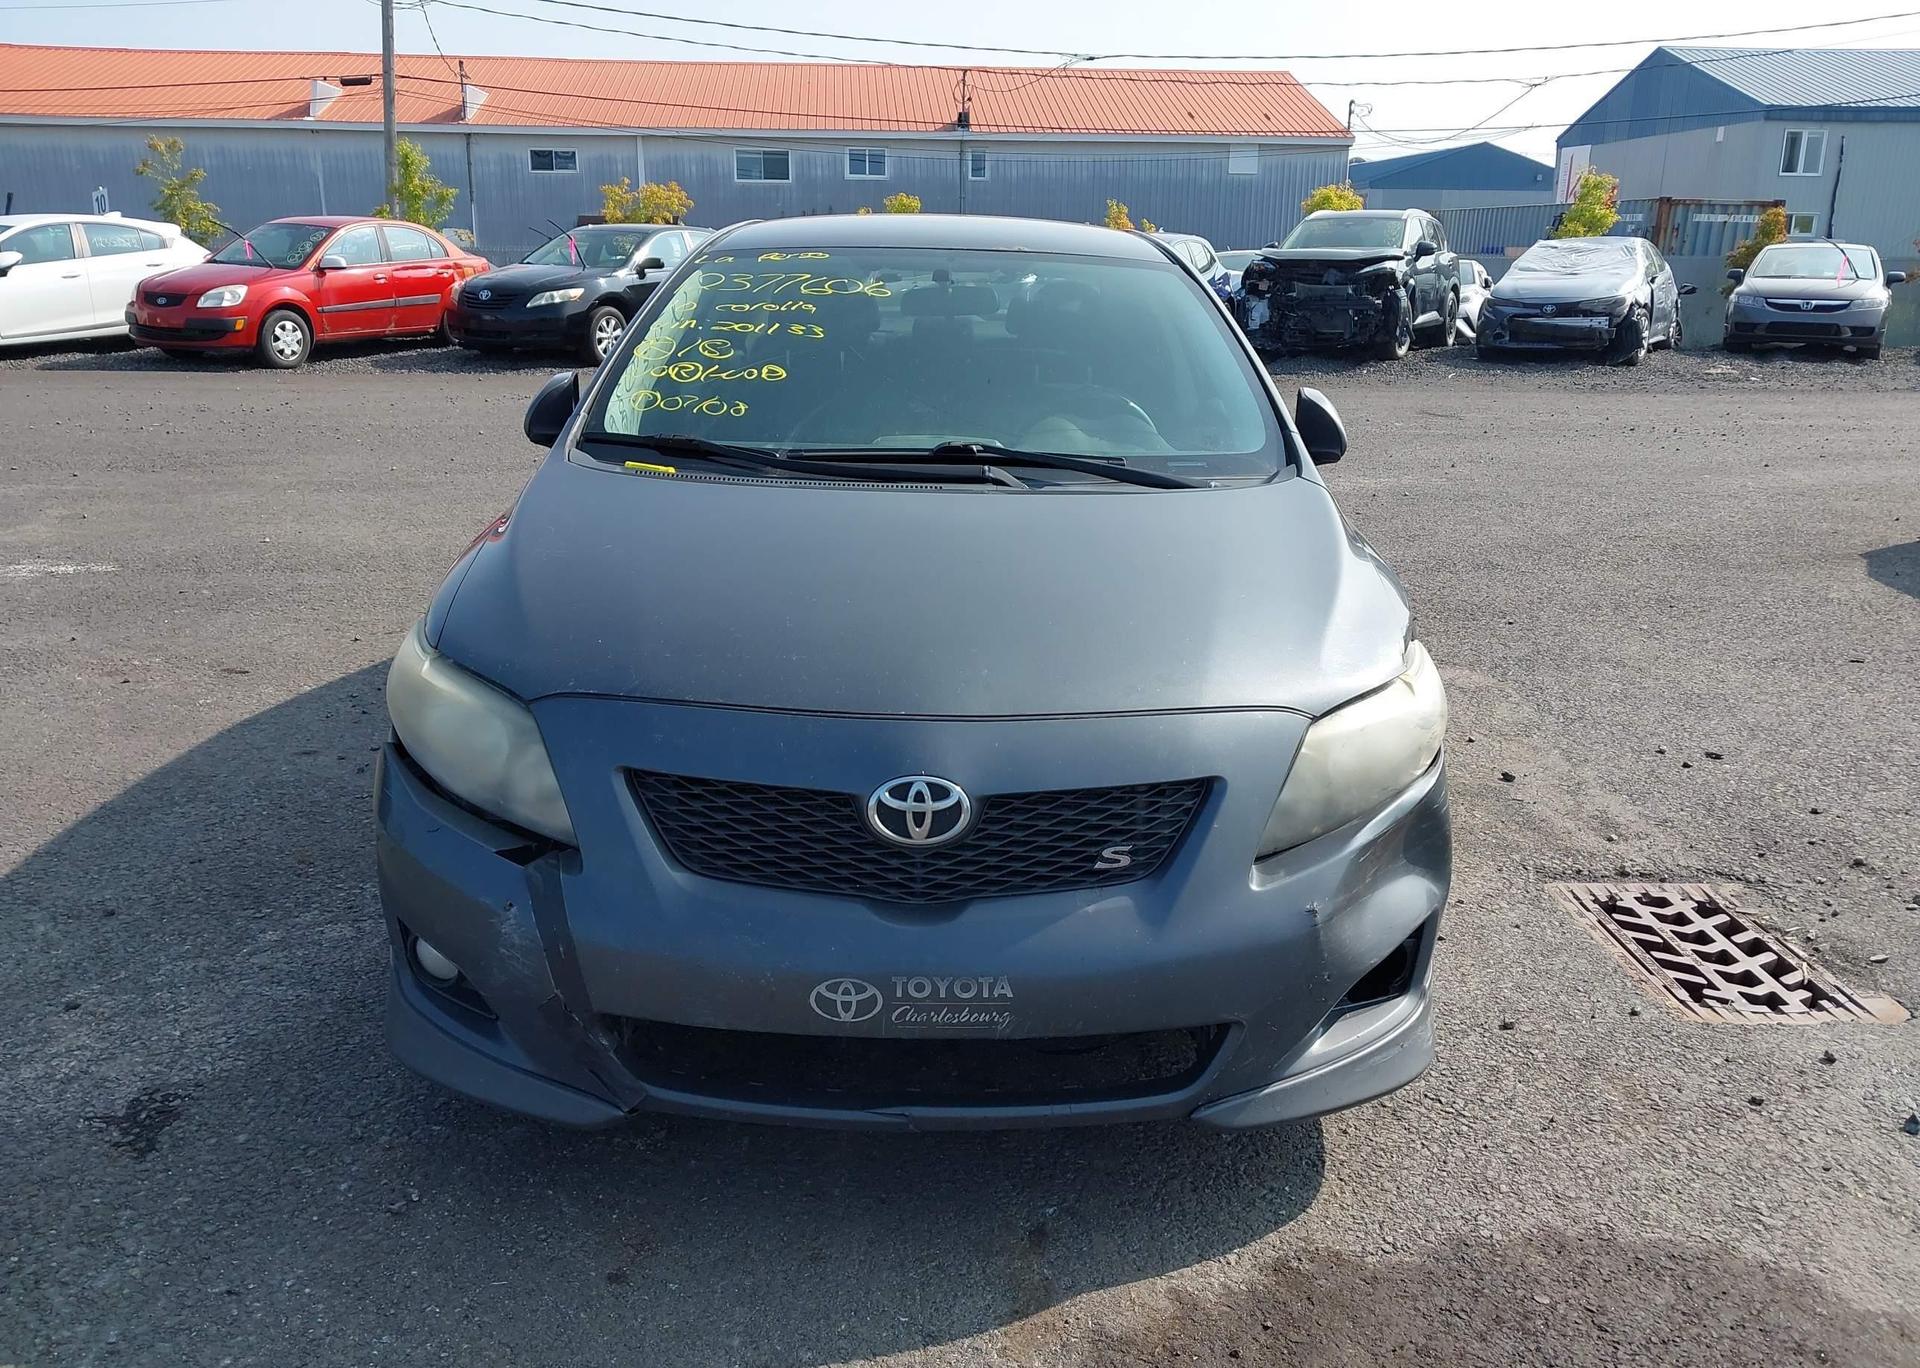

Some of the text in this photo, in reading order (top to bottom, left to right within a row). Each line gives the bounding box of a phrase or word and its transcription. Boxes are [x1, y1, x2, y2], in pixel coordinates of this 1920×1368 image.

[1094, 845, 1133, 869] S
[891, 976, 1013, 998] TOYOTA
[891, 1005, 1015, 1030] Charlesbourg
